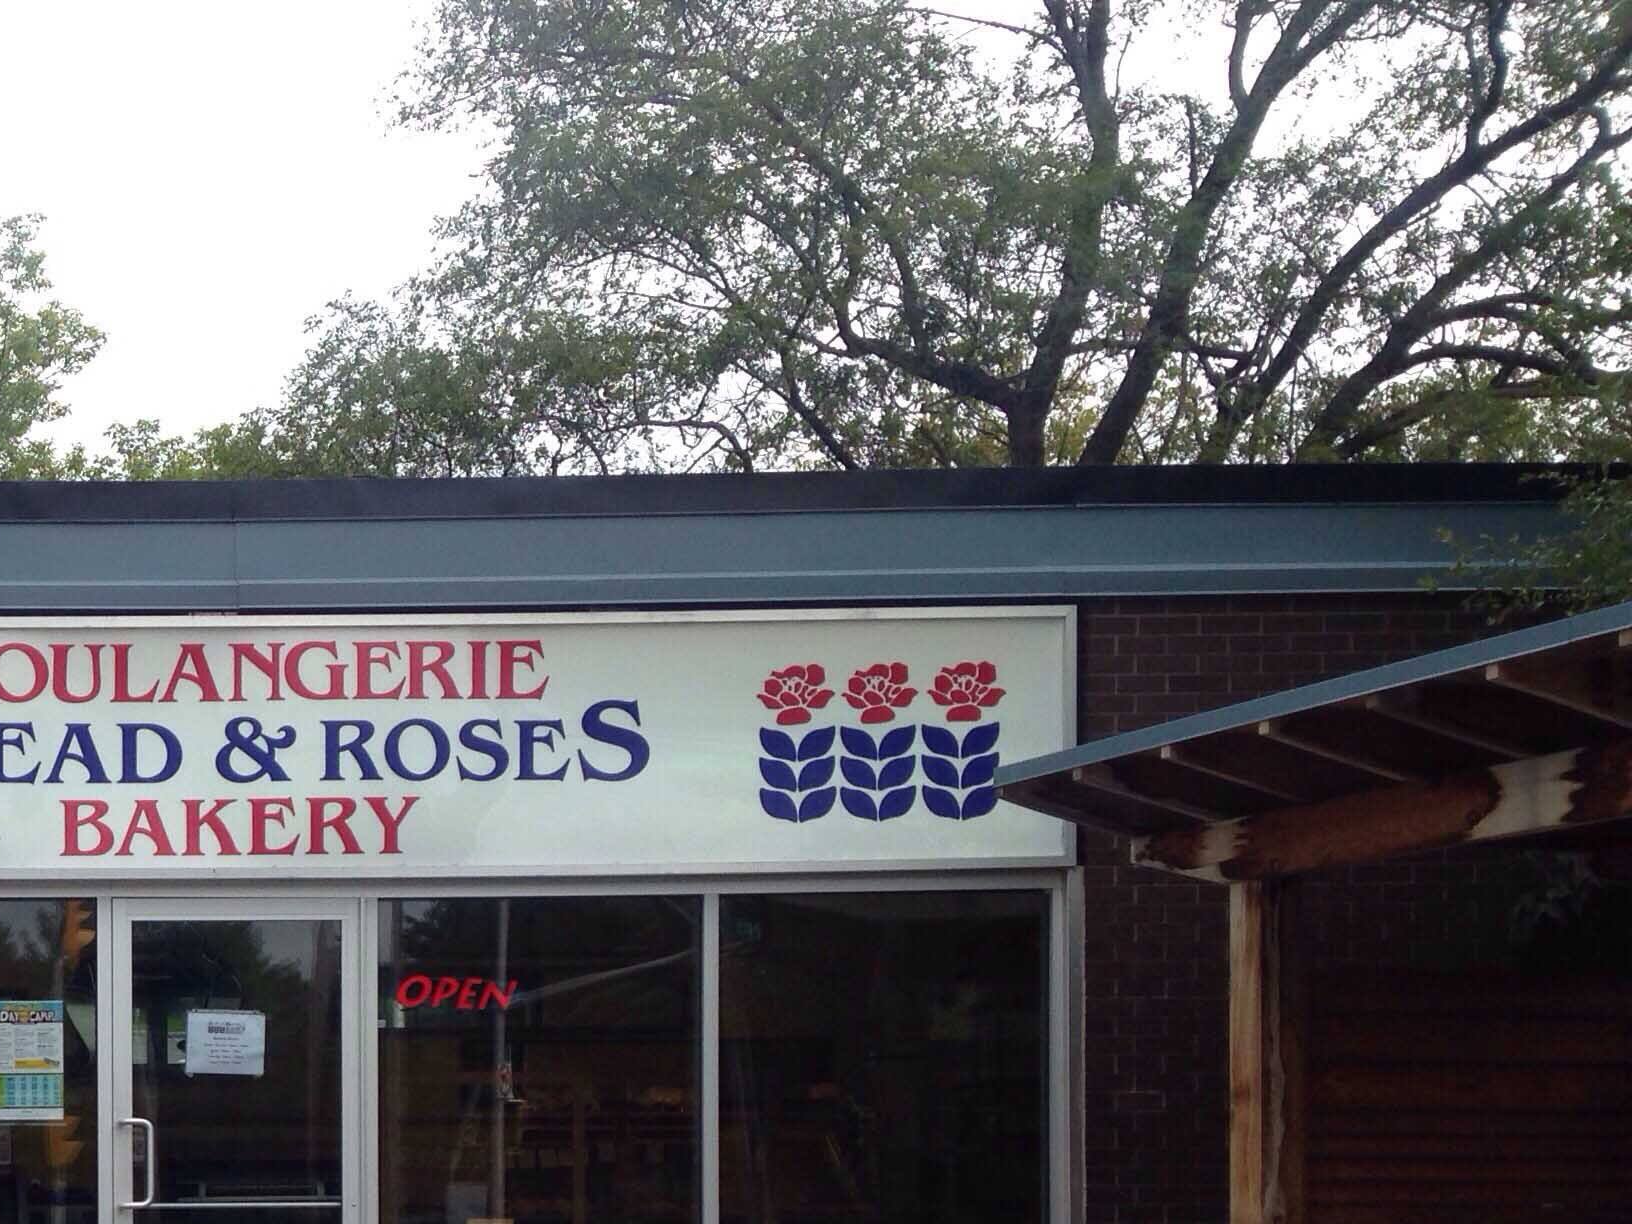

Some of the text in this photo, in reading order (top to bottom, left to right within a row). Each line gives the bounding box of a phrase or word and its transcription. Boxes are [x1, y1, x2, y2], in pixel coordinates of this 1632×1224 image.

[215, 715, 298, 782] &
[318, 698, 652, 782] ROSES
[58, 795, 421, 857] BAKERY
[396, 974, 518, 1010] OPEN
